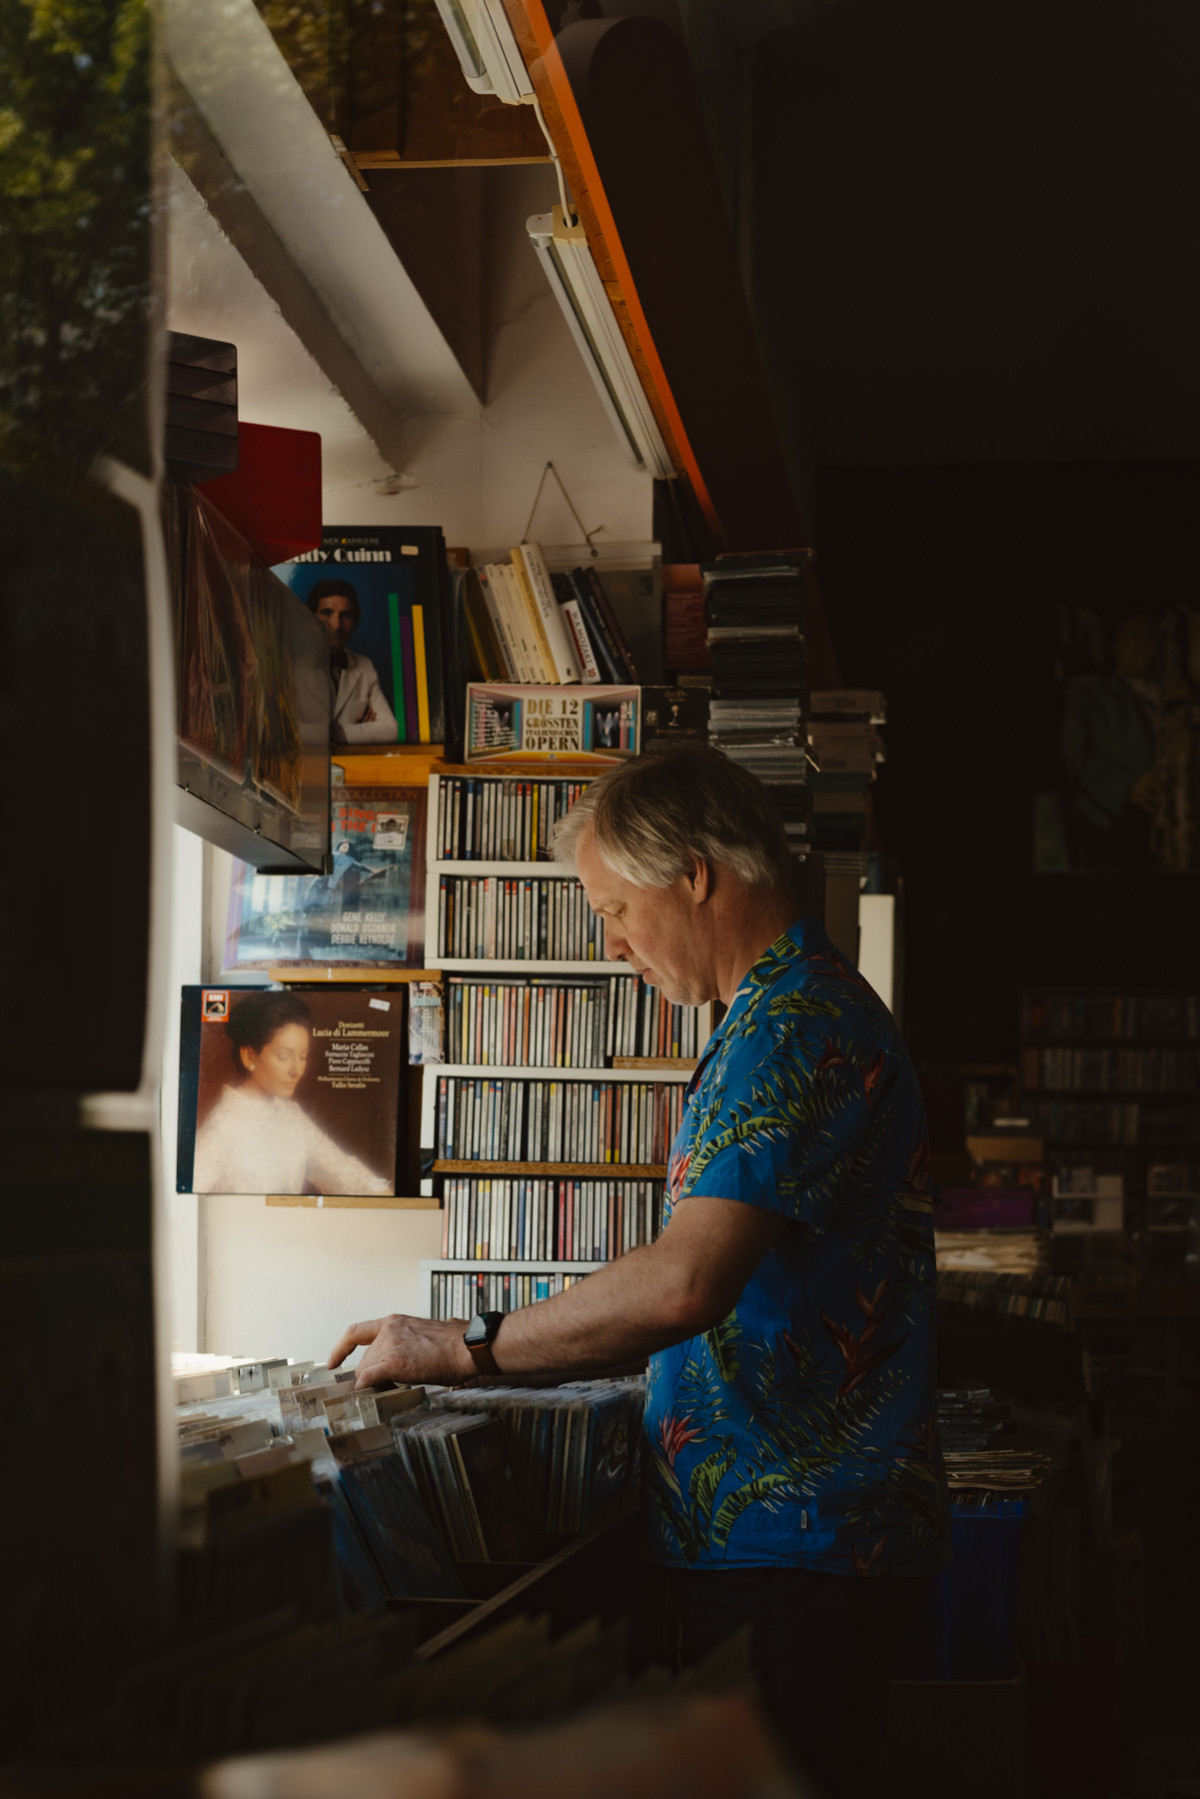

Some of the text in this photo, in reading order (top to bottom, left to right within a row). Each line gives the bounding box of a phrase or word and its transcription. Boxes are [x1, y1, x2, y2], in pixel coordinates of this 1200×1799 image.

[333, 548, 392, 563] Quinn
[576, 628, 592, 664] MOZART
[586, 667, 596, 678] 10
[526, 699, 579, 715] DIE 12
[526, 714, 579, 729] GRÖSSTEN
[526, 738, 579, 750] OPERN
[340, 789, 418, 799] COLLECTION
[339, 820, 367, 832] THE
[312, 1028, 390, 1037] Lucia di Lammermoor
[331, 1043, 369, 1051] Maria Callas
